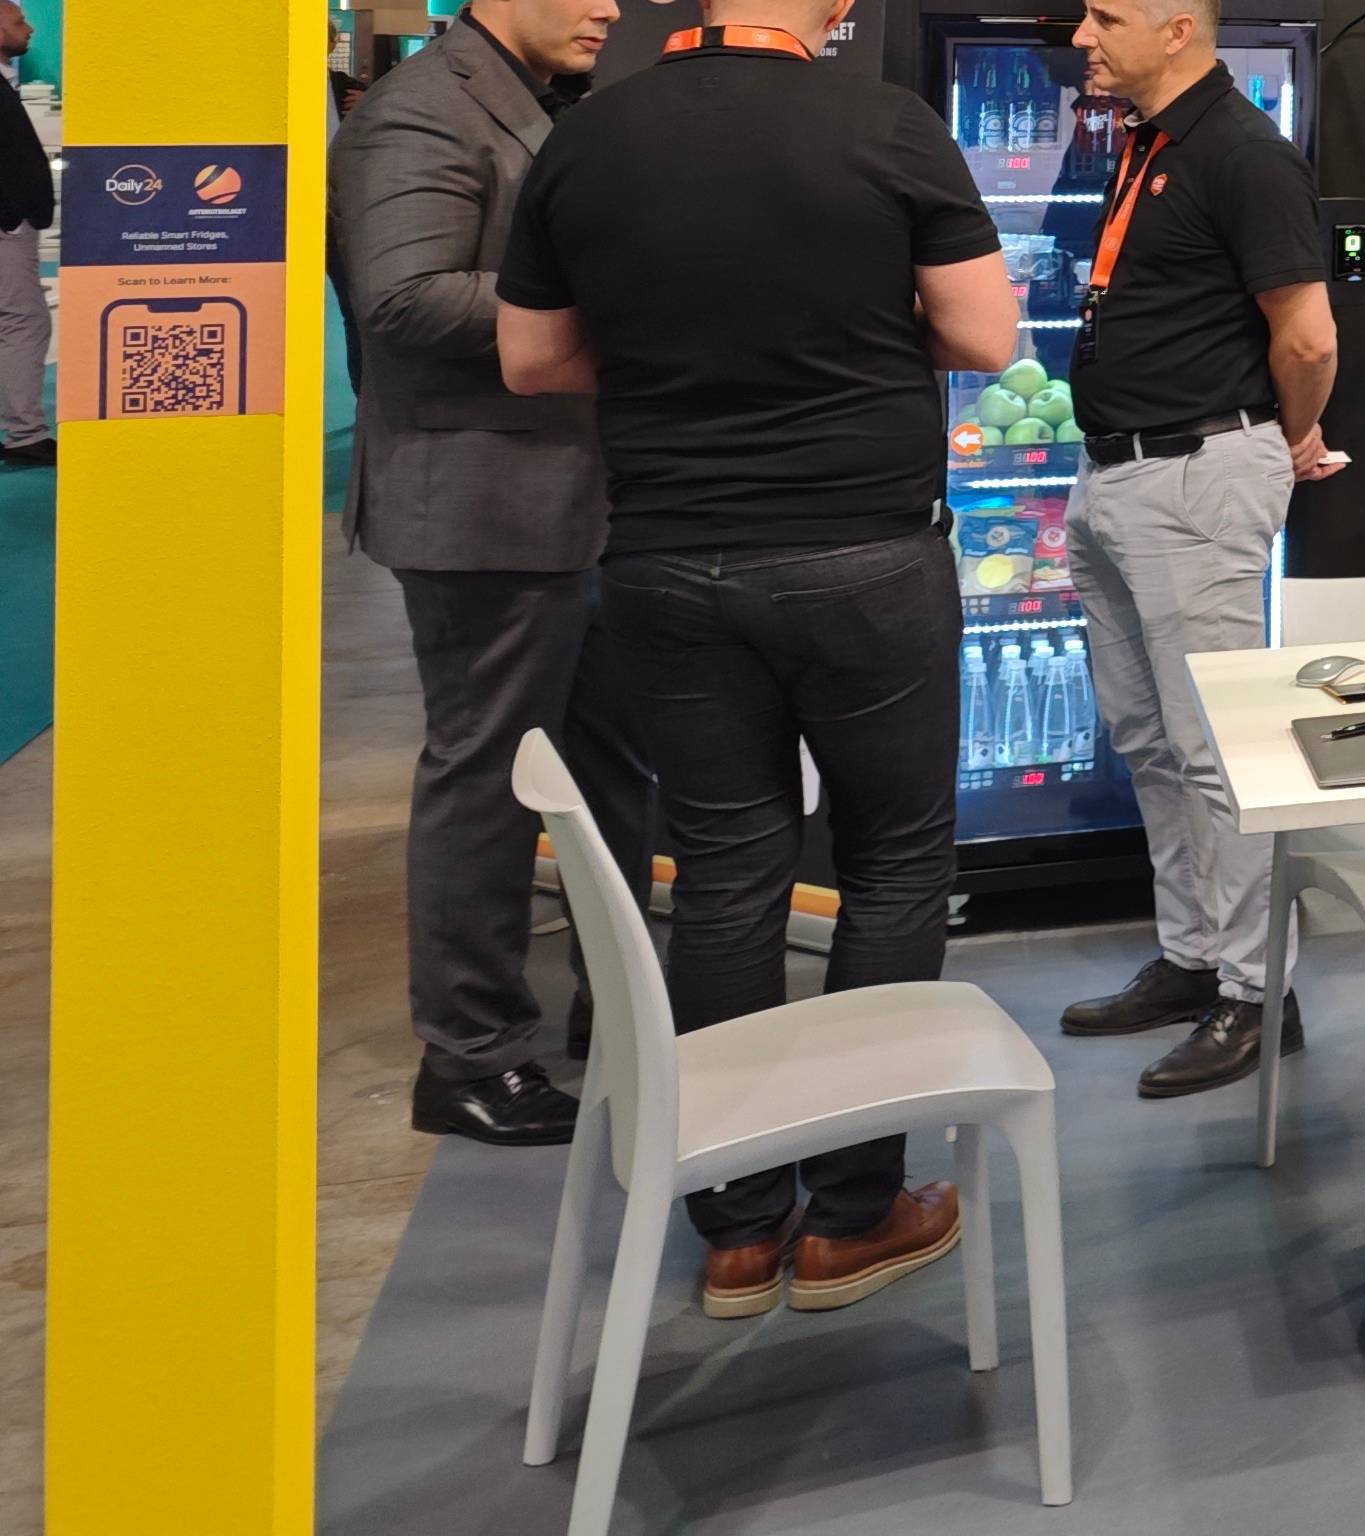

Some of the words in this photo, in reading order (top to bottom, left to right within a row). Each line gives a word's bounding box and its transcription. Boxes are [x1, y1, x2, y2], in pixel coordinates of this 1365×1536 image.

[105, 178, 163, 194] Daily24
[160, 231, 189, 240] Smart
[186, 242, 218, 251] Stores
[117, 276, 146, 286] Scan
[150, 277, 160, 286] to
[163, 276, 196, 286] Learn
